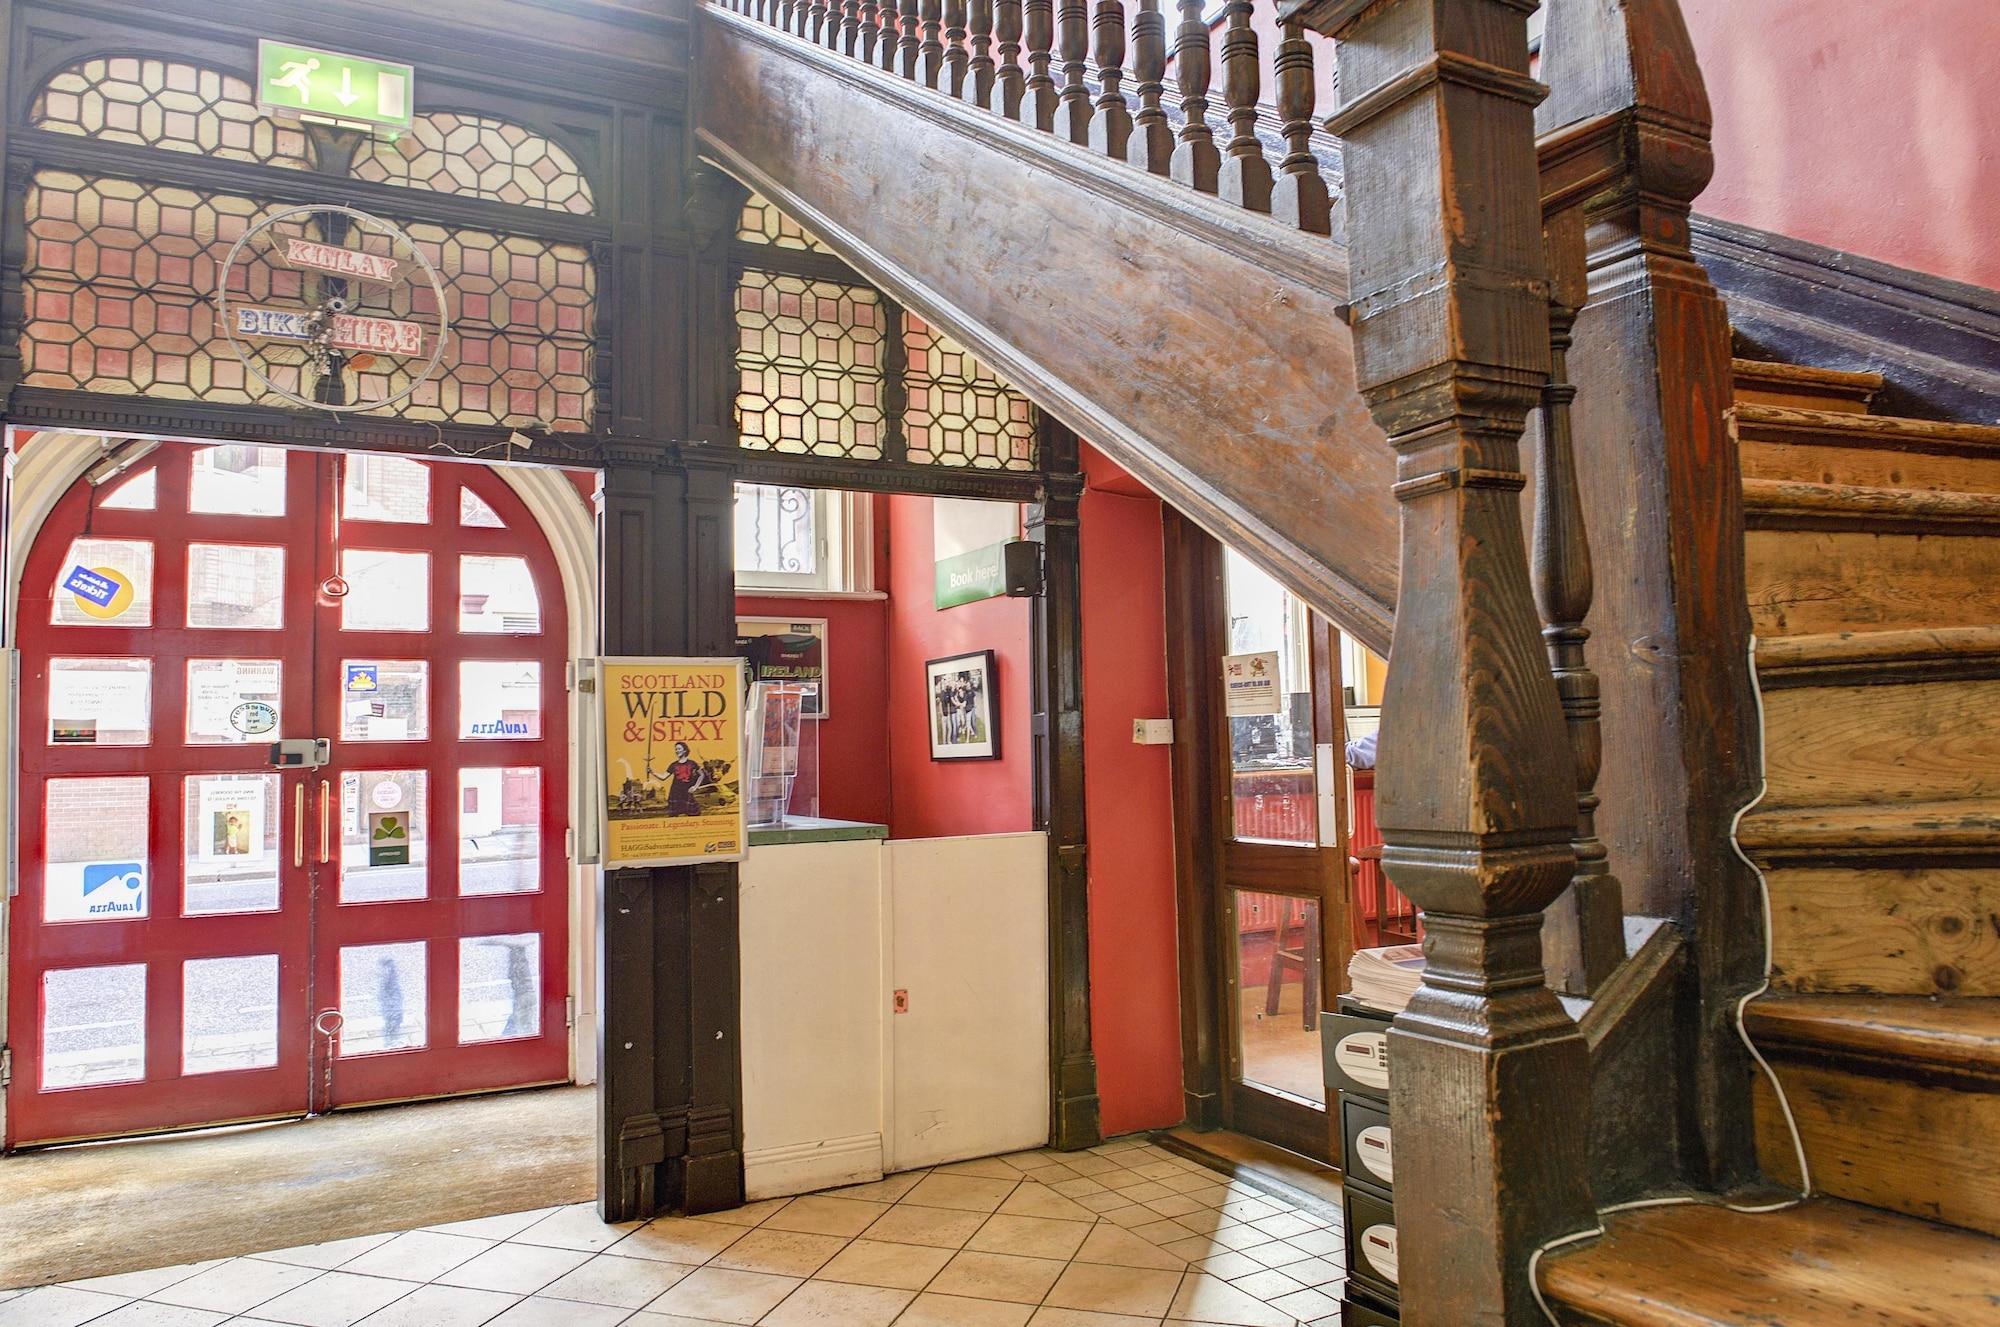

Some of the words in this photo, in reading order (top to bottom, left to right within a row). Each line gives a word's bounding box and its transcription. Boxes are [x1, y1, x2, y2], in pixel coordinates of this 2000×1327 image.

[287, 239, 398, 282] KINLAY
[331, 313, 421, 356] HIRE
[950, 567, 974, 589] Book
[621, 674, 726, 690] SCOTLAND
[761, 665, 823, 678] IRELAND
[621, 690, 727, 719] WILD
[623, 720, 646, 743] &
[652, 719, 727, 742] SEXY
